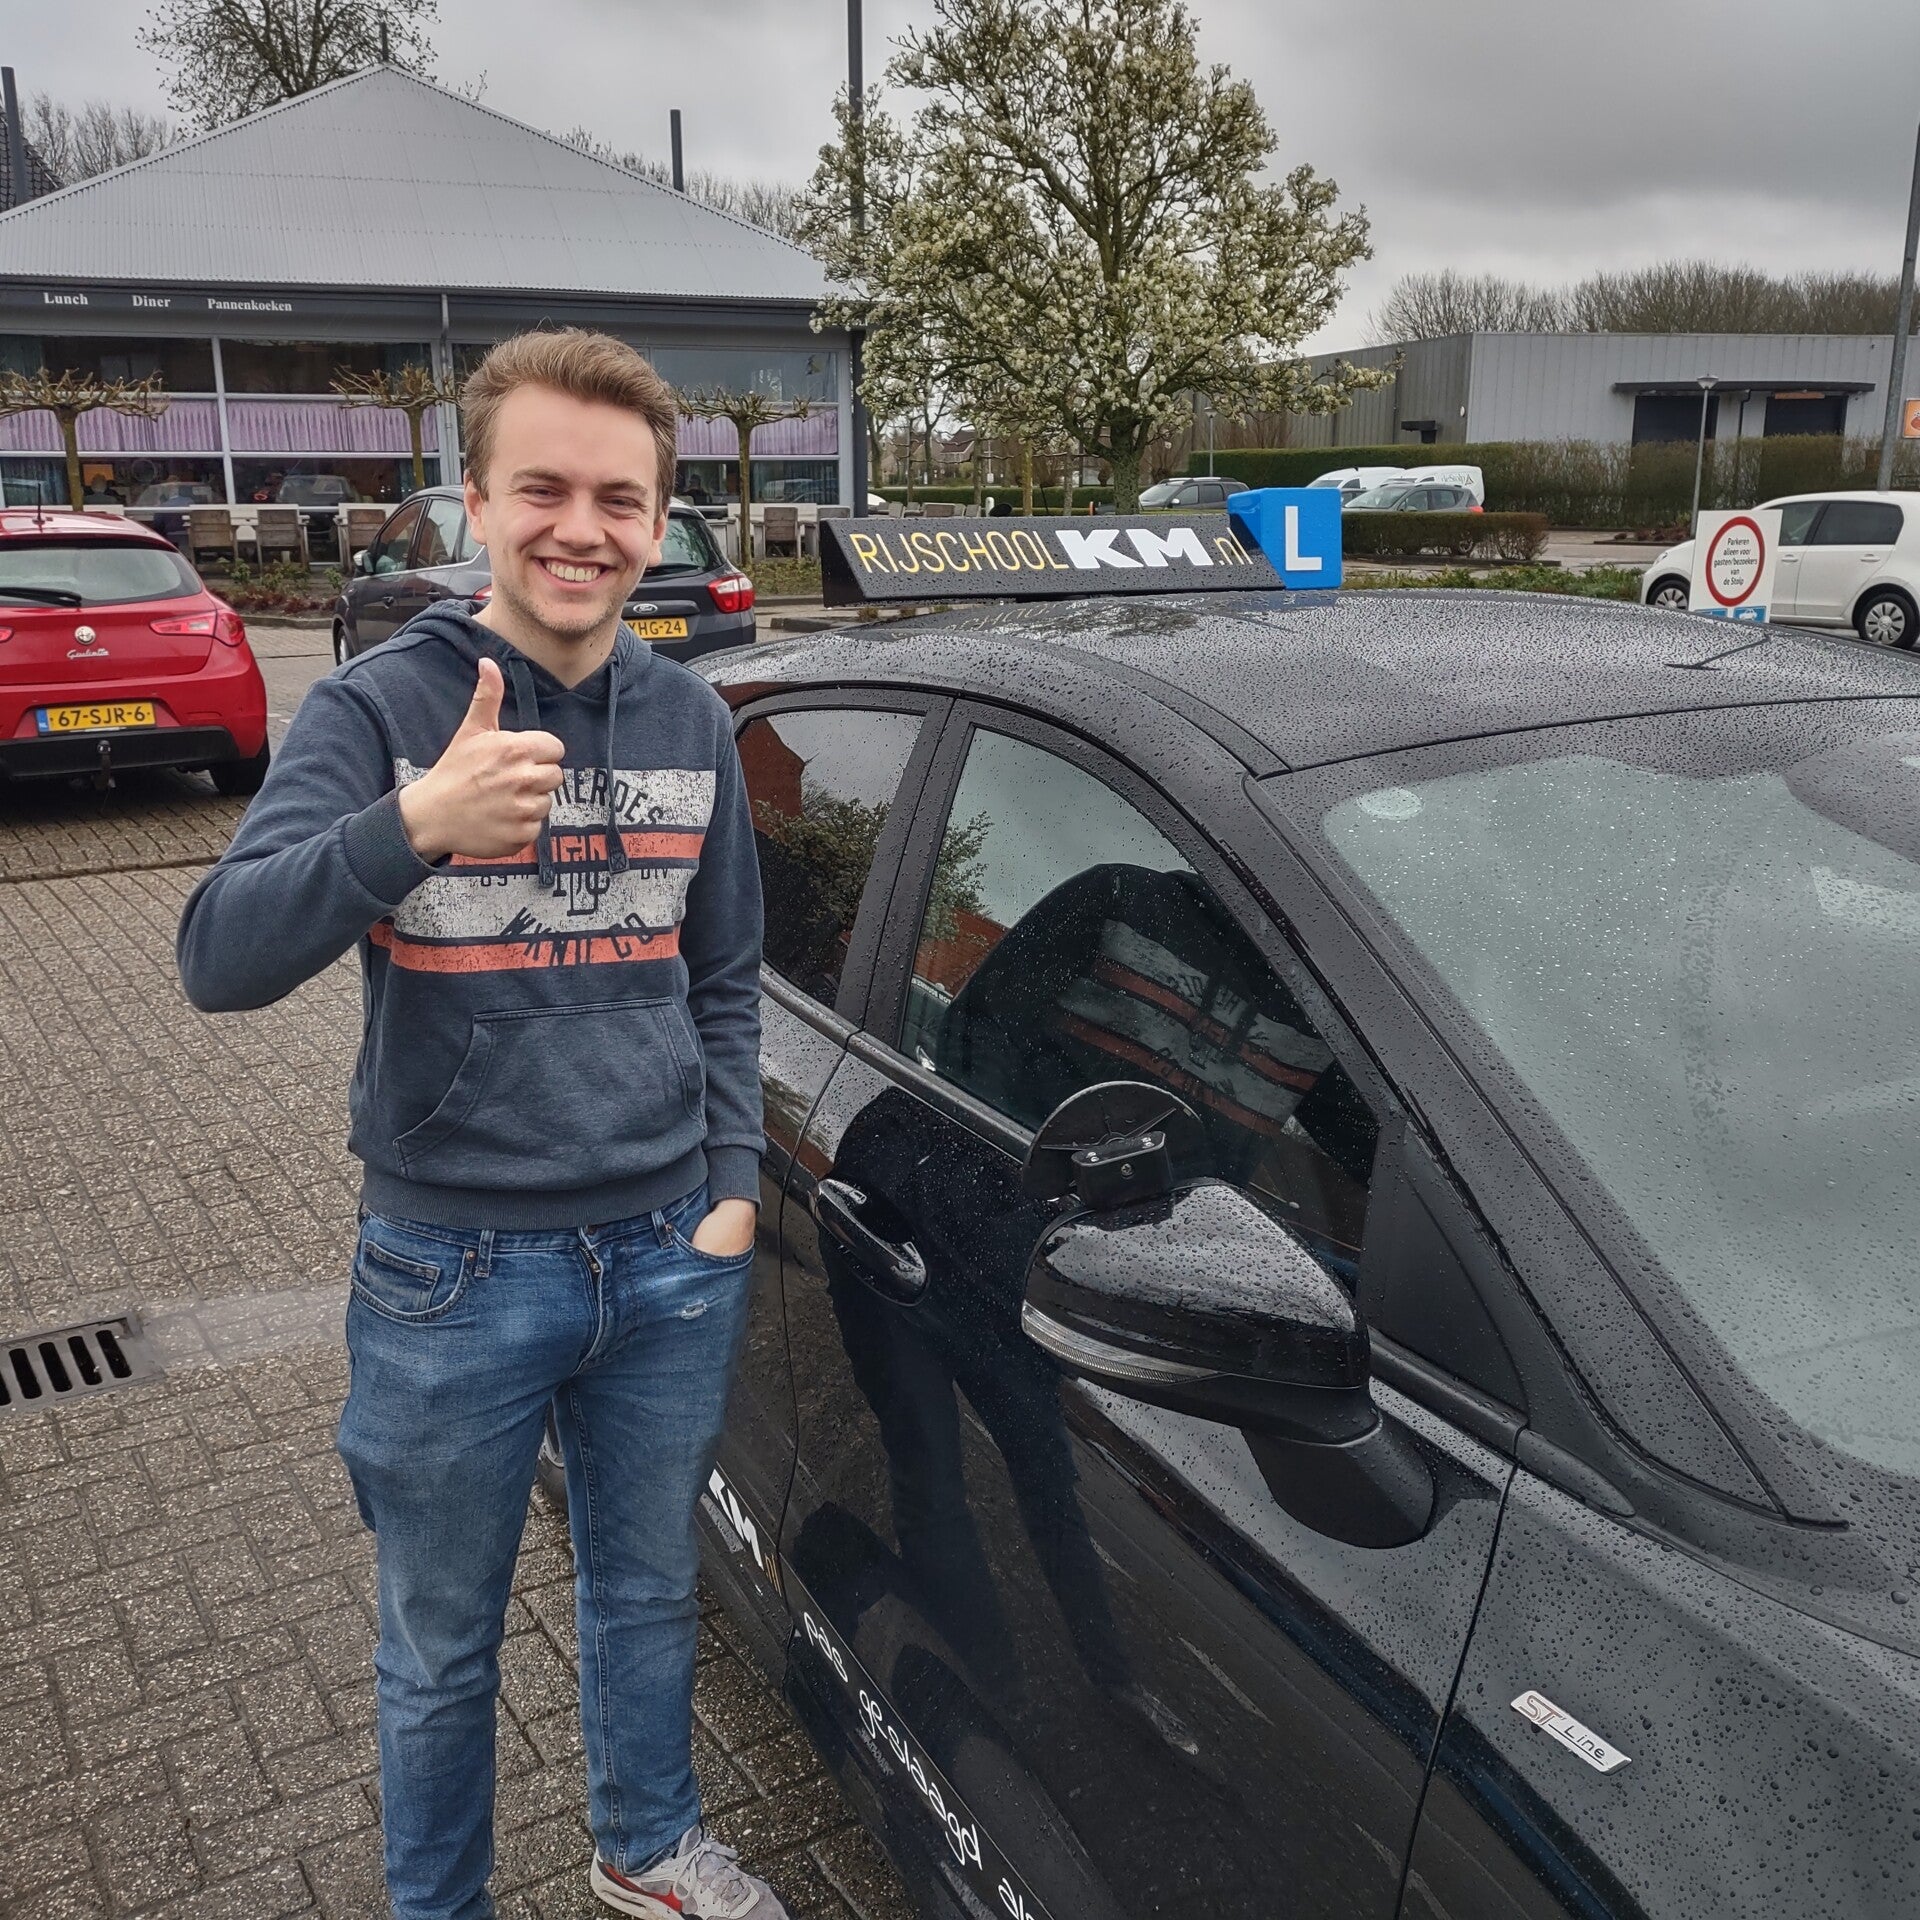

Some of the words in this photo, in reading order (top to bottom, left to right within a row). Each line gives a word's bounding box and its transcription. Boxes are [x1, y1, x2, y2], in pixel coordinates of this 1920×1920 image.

[43, 292, 89, 305] Lunch
[132, 294, 171, 308] Diner
[207, 298, 293, 312] Pannenkoeken
[1284, 505, 1322, 571] L
[1727, 537, 1750, 546] Parkeren
[1723, 547, 1739, 556] alleen
[1713, 557, 1758, 568] gasten/bezoekers
[1722, 577, 1730, 586] de
[1730, 576, 1744, 586] Stolp
[58, 706, 146, 727] 67-SJR-6
[1518, 1694, 1566, 1726] ST
[1564, 1725, 1605, 1758] Line
[858, 1689, 983, 1871] geslaagd
